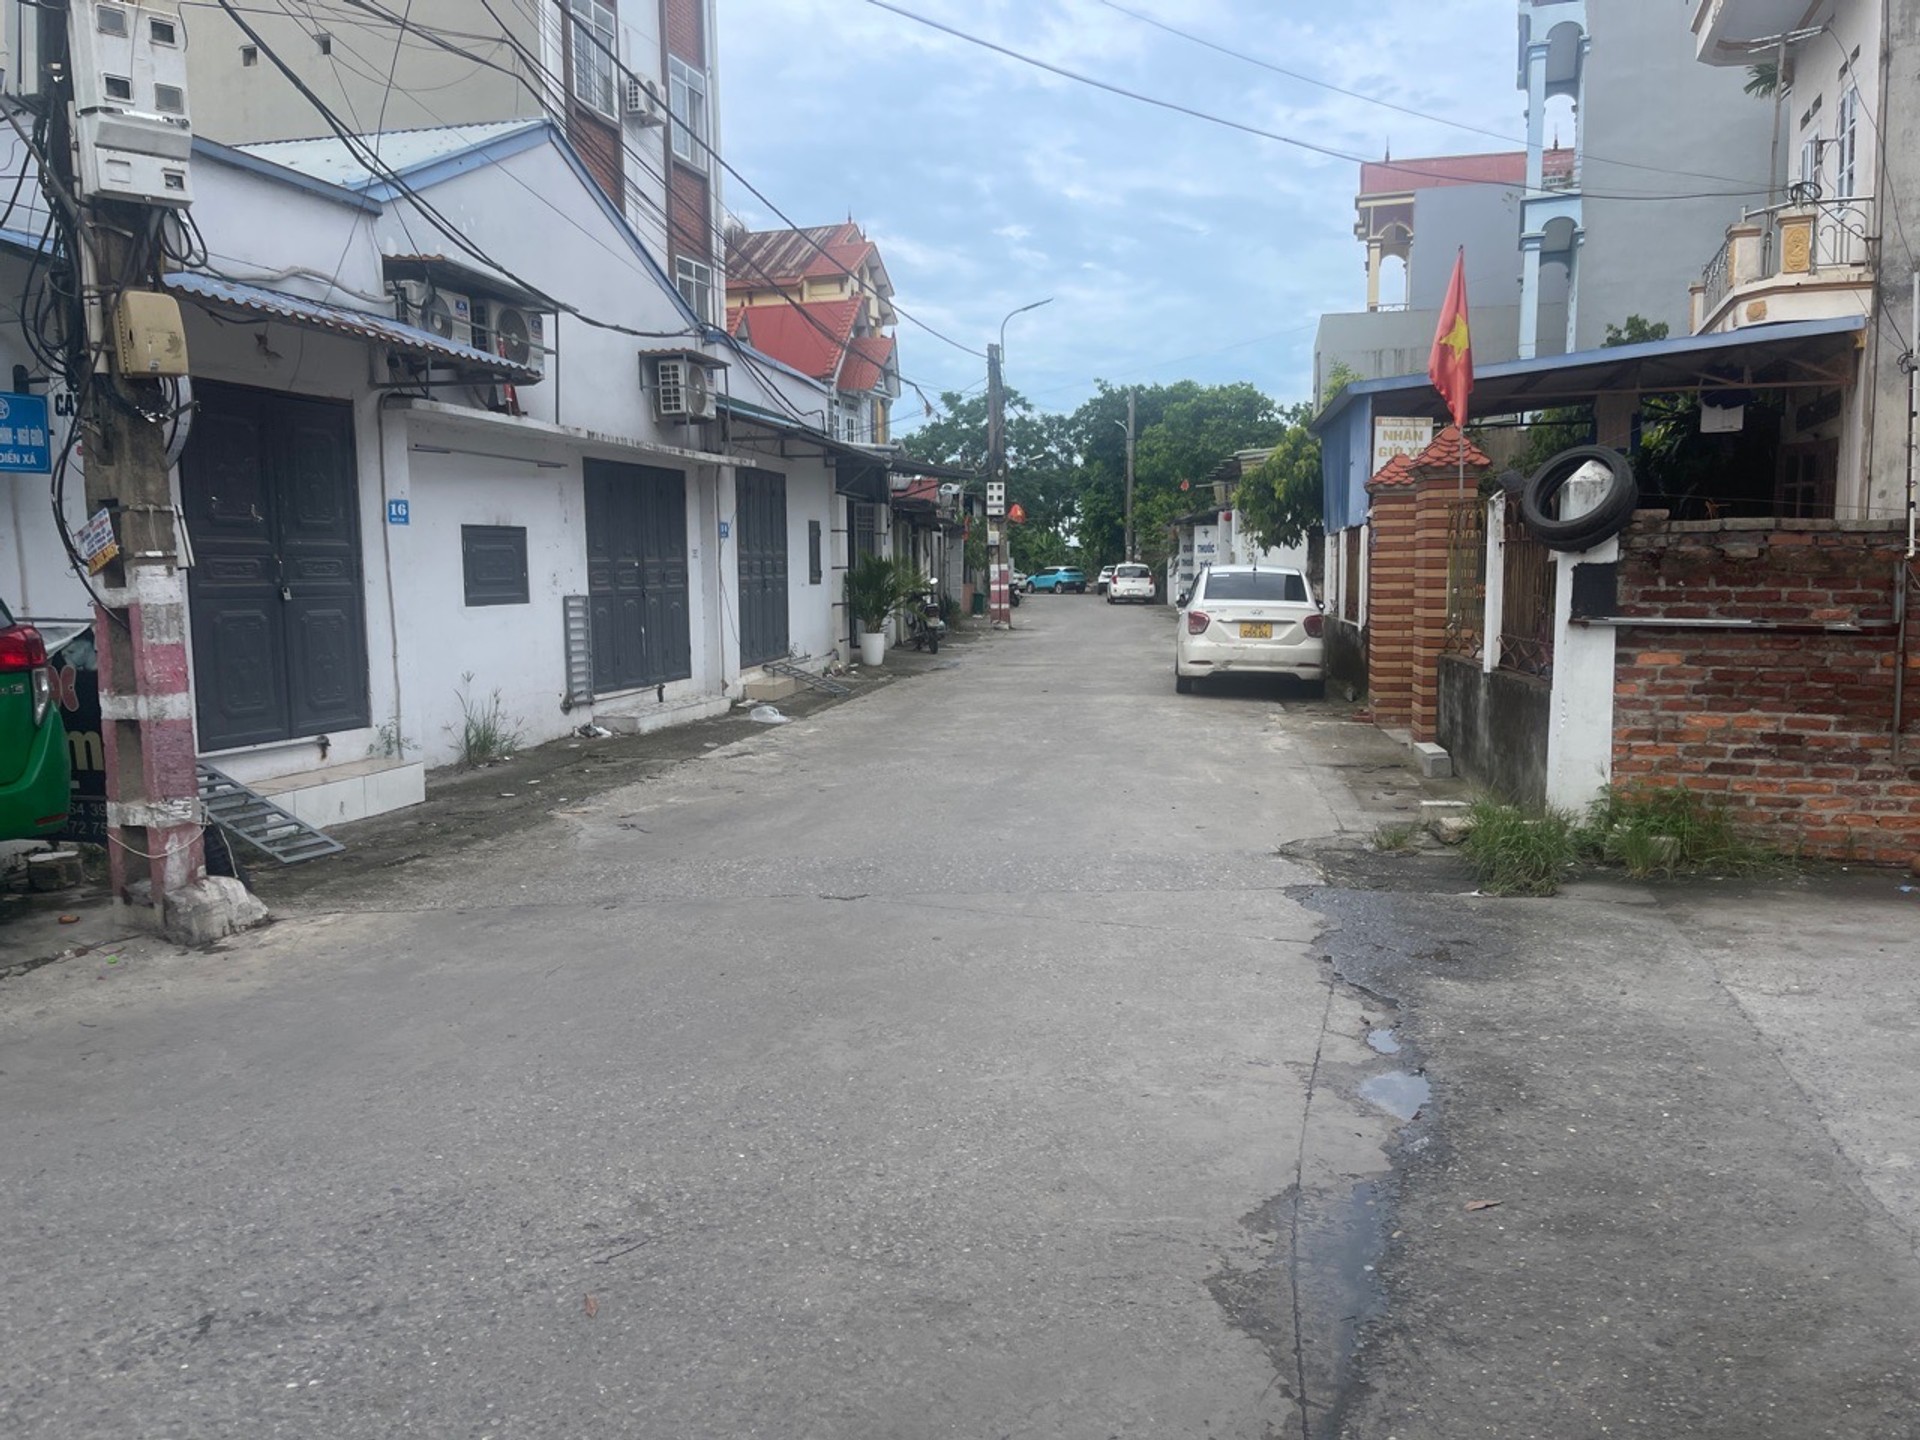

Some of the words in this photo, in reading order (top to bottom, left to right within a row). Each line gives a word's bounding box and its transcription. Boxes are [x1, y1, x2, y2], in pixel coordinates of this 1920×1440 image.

[1383, 428, 1423, 444] NHẬN
[22, 451, 37, 465] XÁ
[390, 503, 407, 516] 16
